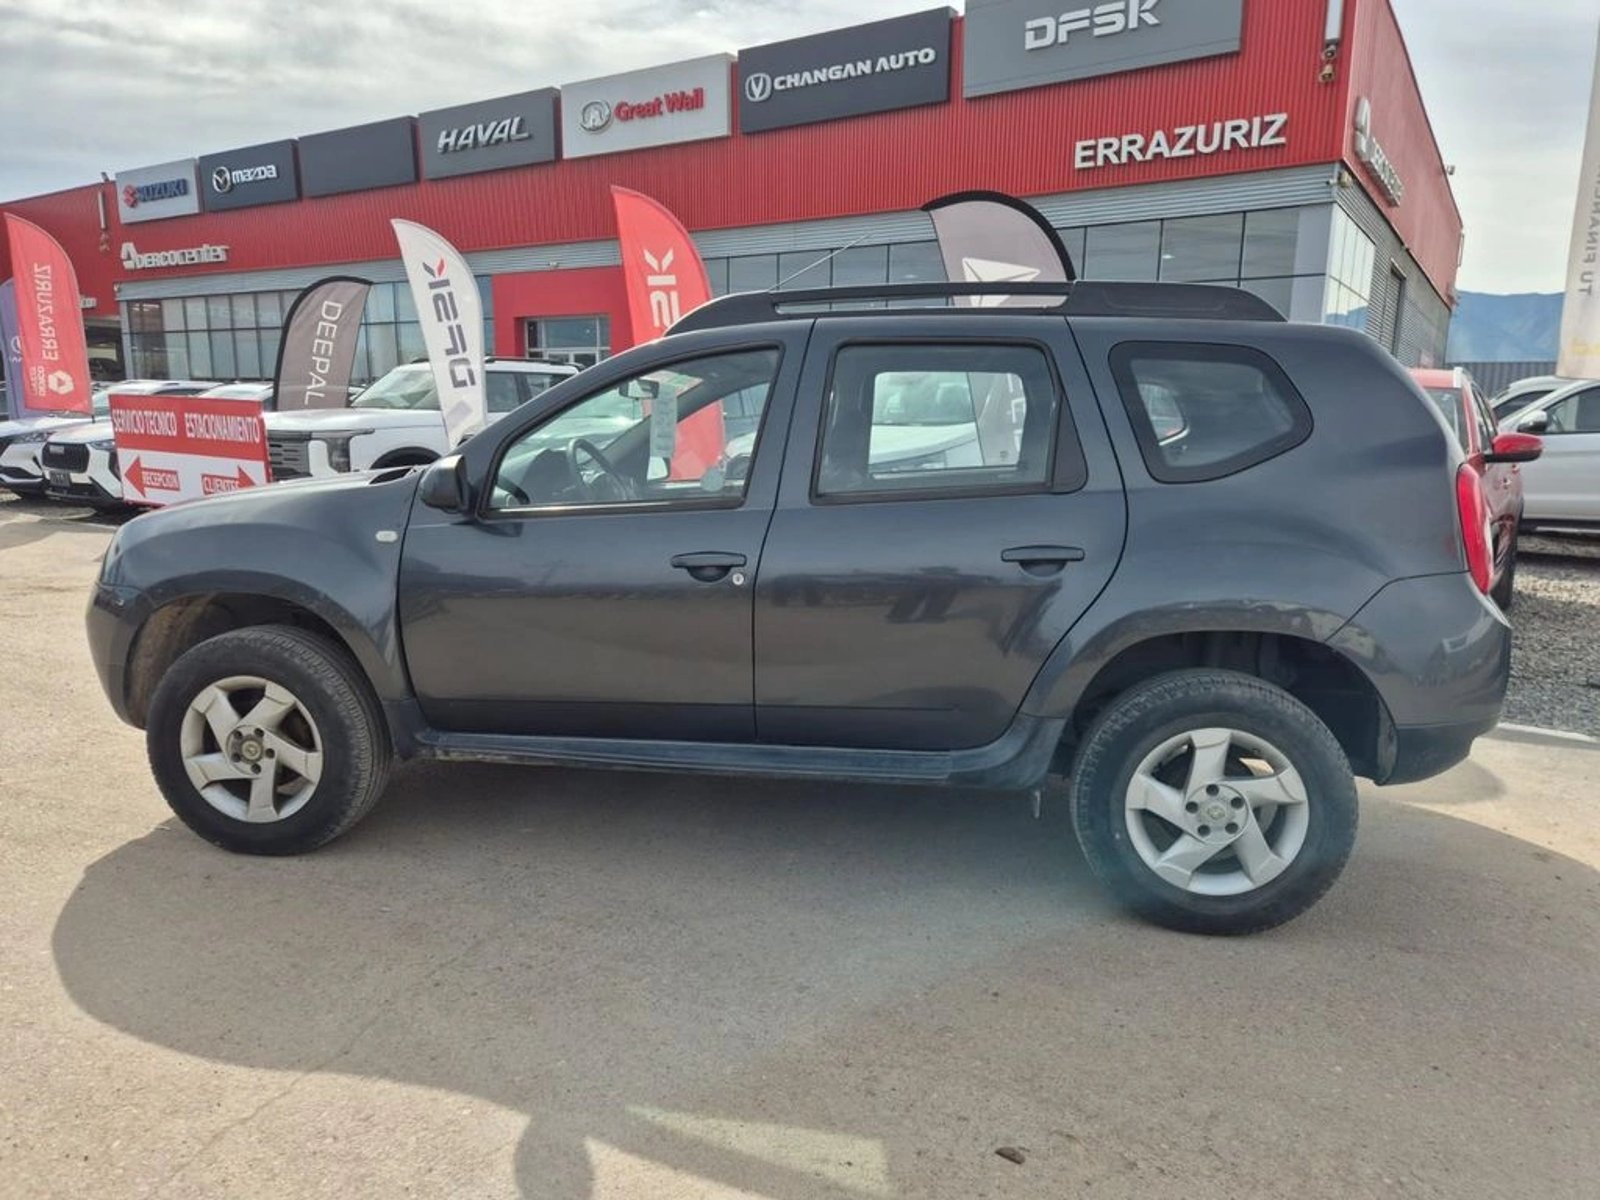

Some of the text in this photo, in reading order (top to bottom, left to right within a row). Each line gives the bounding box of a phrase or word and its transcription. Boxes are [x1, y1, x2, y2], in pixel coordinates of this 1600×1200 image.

[1024, 0, 1161, 51] DFSK
[773, 47, 936, 91] CHANGAN AUTO
[614, 86, 704, 122] Great Wall
[437, 115, 530, 153] HAVAL
[1074, 112, 1289, 169] ERRAZURIZ
[232, 164, 277, 185] mazda
[304, 300, 344, 405] DEEPAL
[111, 409, 178, 437] SERVICIO TECNICO
[184, 412, 261, 444] ESTACIONAMIENTO
